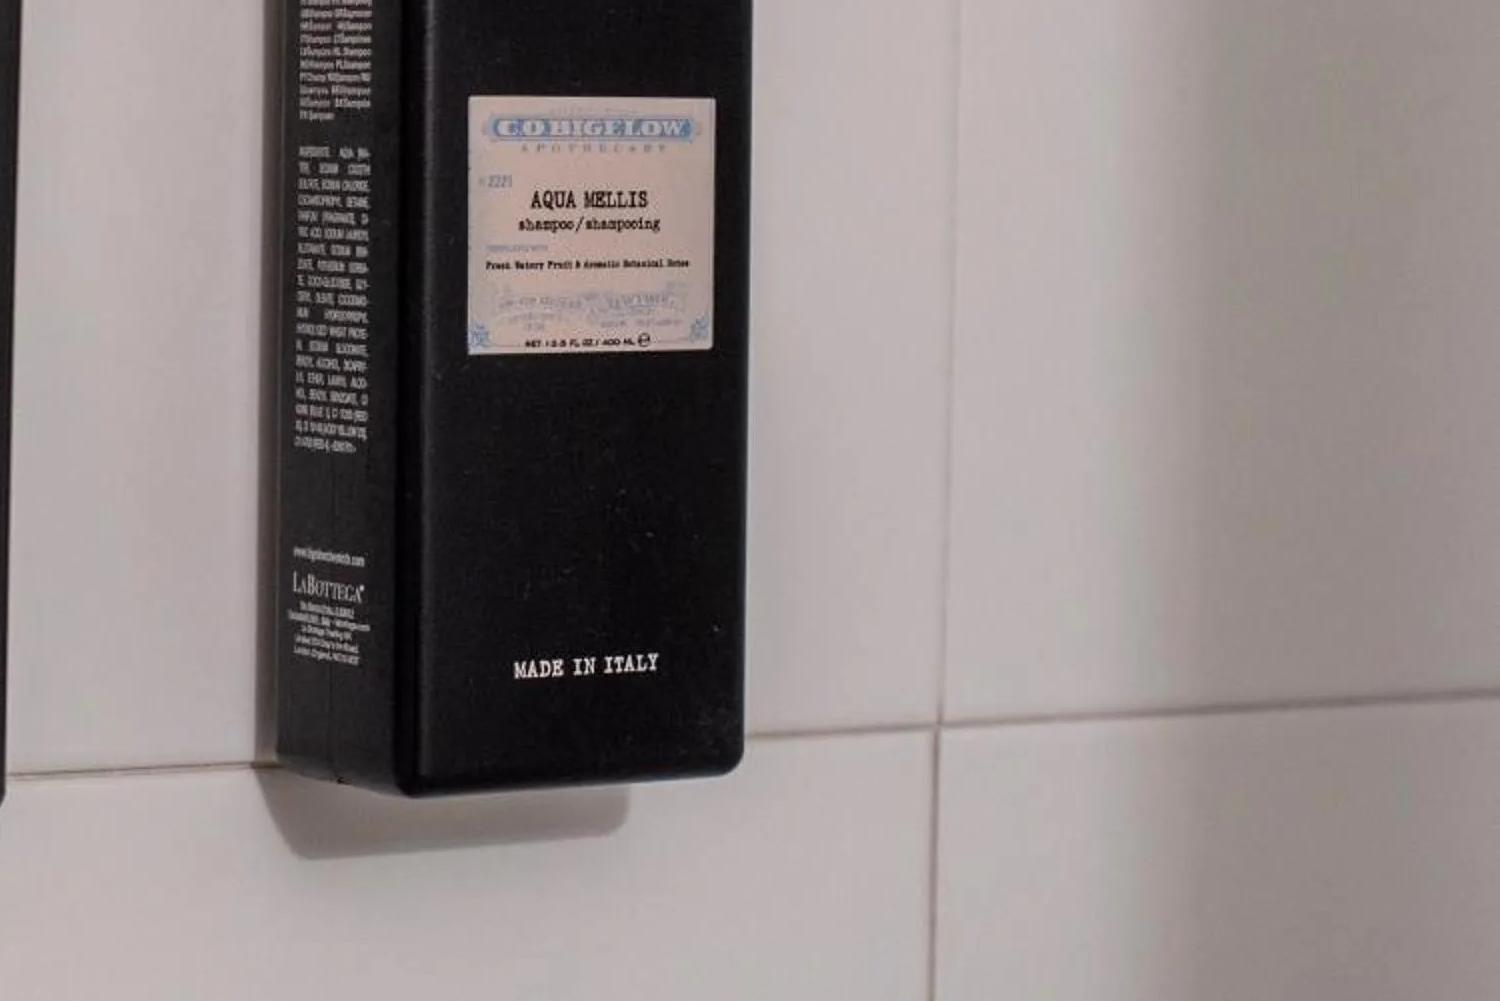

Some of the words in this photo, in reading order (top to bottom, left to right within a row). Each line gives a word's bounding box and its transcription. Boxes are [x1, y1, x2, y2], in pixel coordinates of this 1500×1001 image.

[531, 190, 577, 210] AQUA
[584, 190, 649, 209] MELLIS
[514, 659, 565, 679] MADE
[573, 657, 597, 676] IN
[604, 652, 659, 674] ITALY
